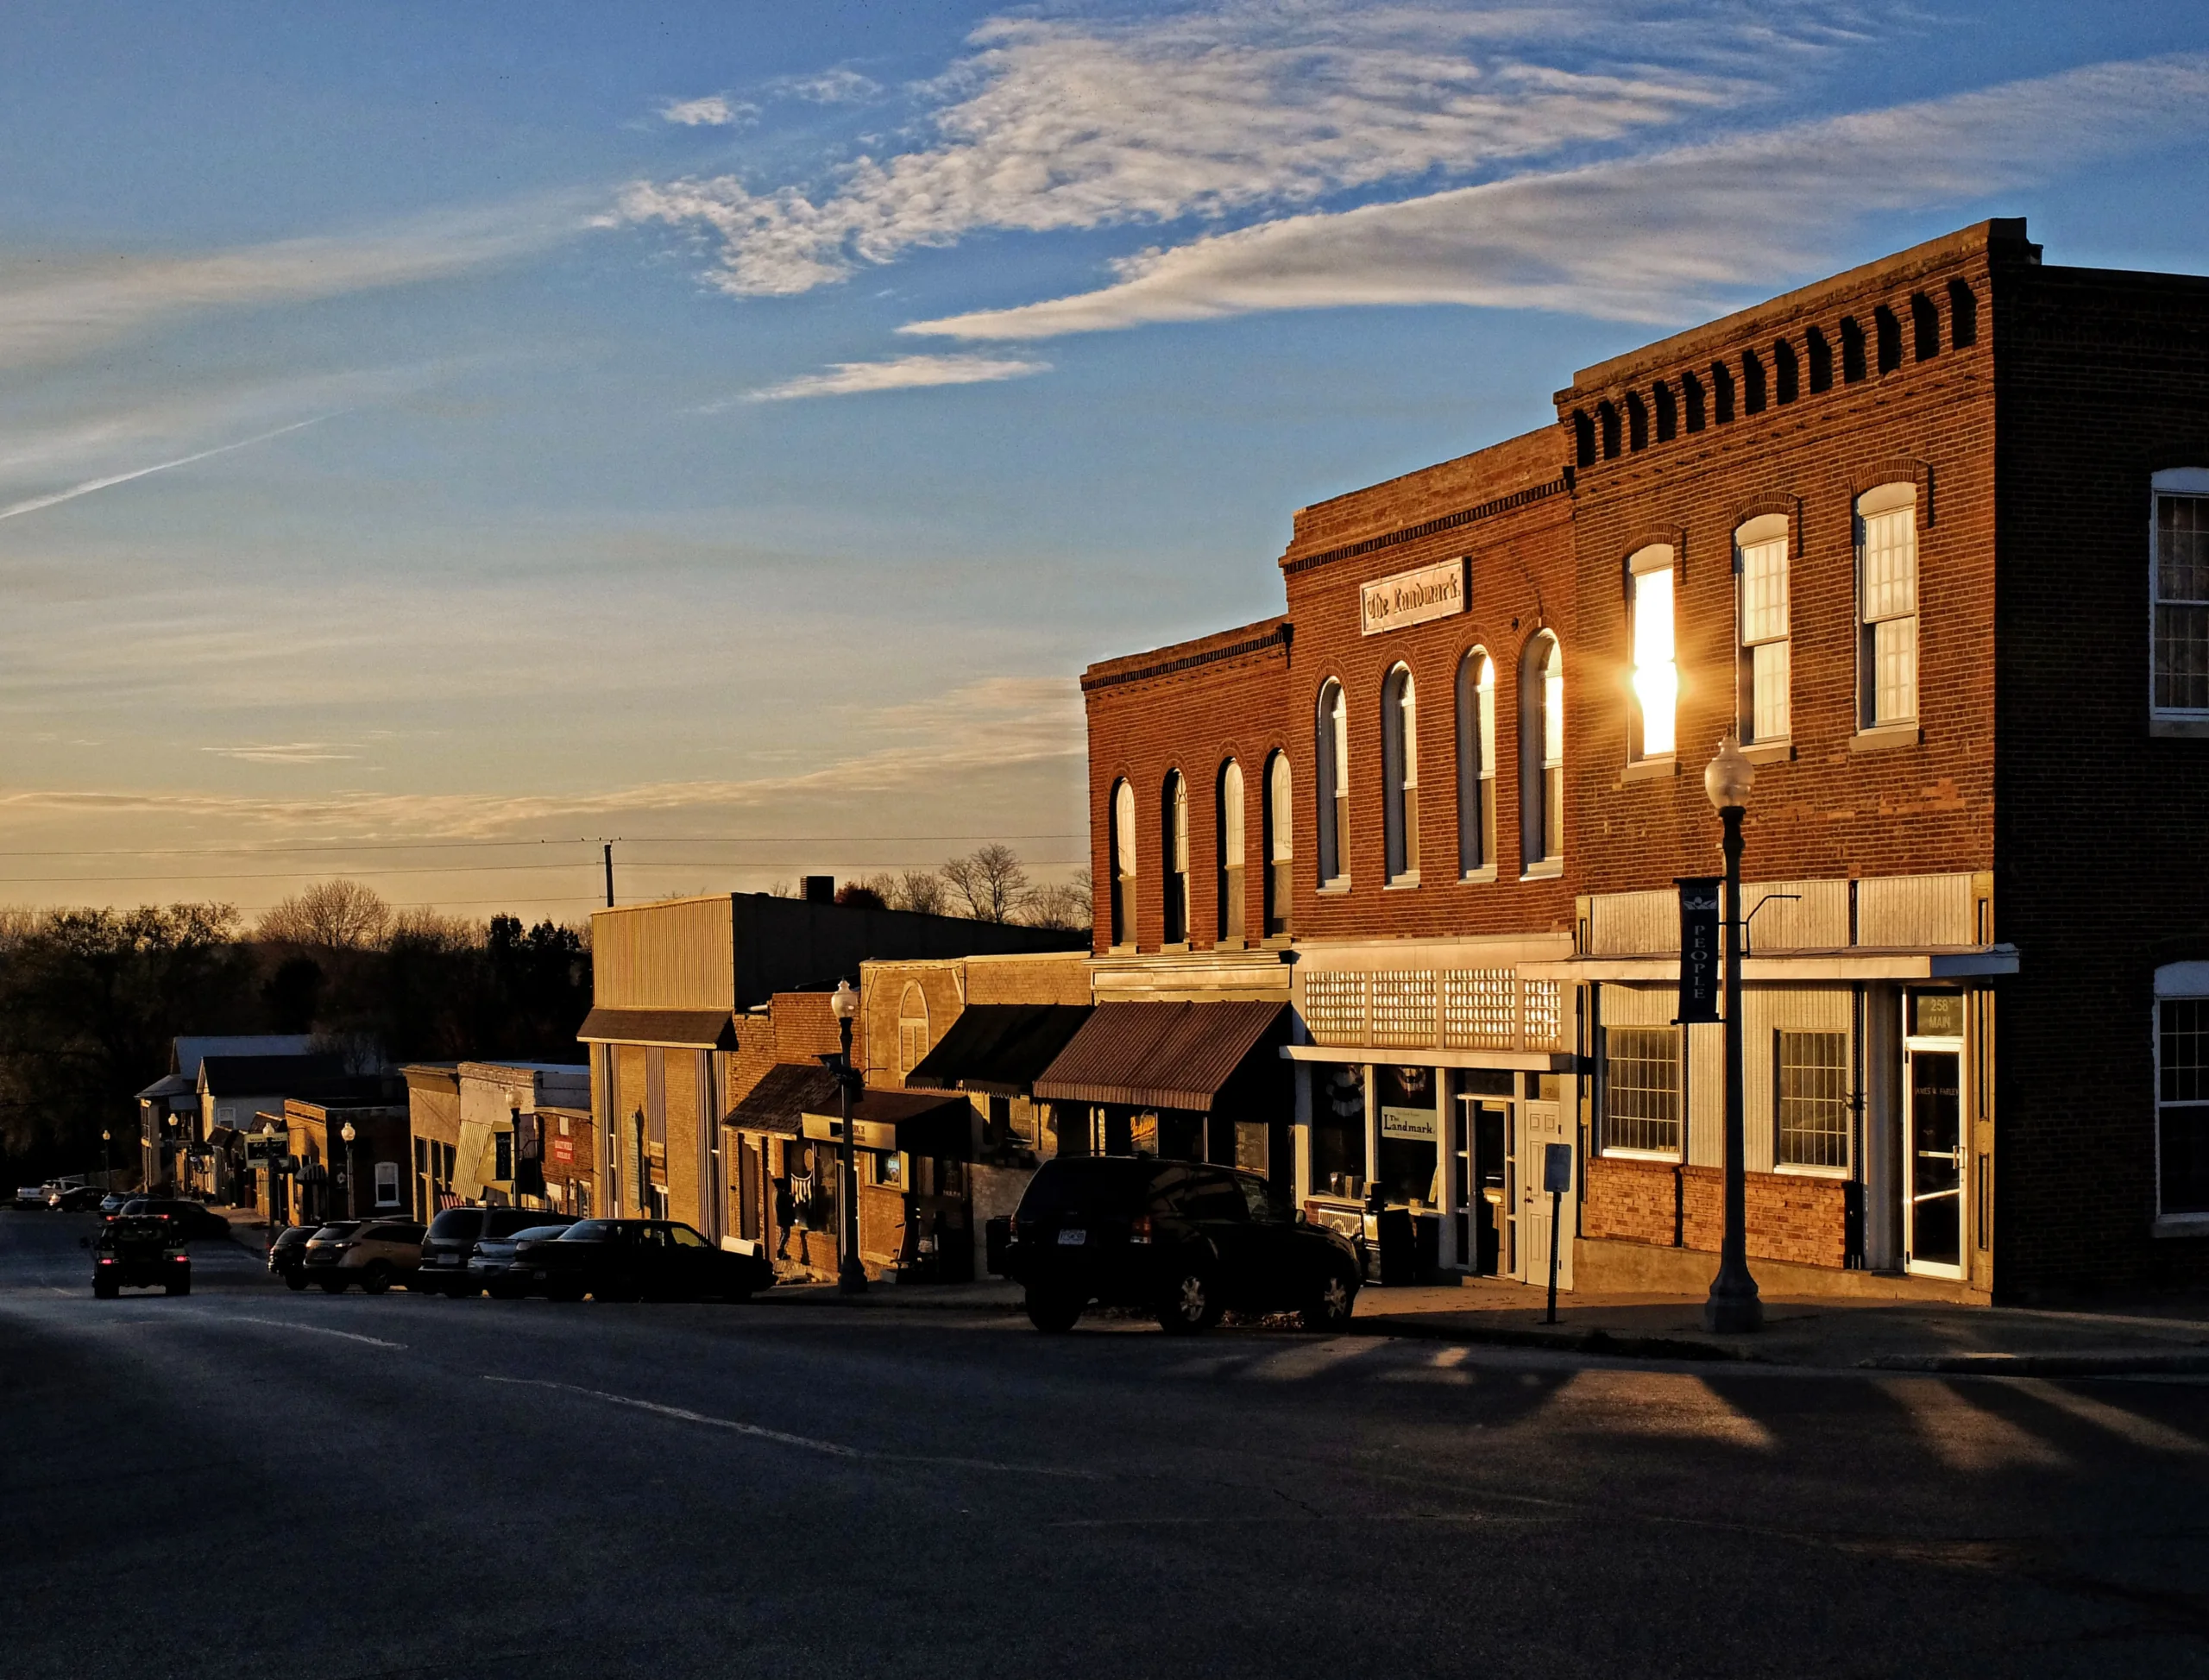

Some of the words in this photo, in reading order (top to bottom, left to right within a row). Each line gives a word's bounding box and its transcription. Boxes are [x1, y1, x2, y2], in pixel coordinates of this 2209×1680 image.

[1367, 593, 1389, 619] The
[1690, 925, 1708, 999] PEOPLE
[1930, 998, 1949, 1012] 258
[1929, 1016, 1951, 1029] MAIN
[1383, 1114, 1433, 1134] Landmark
